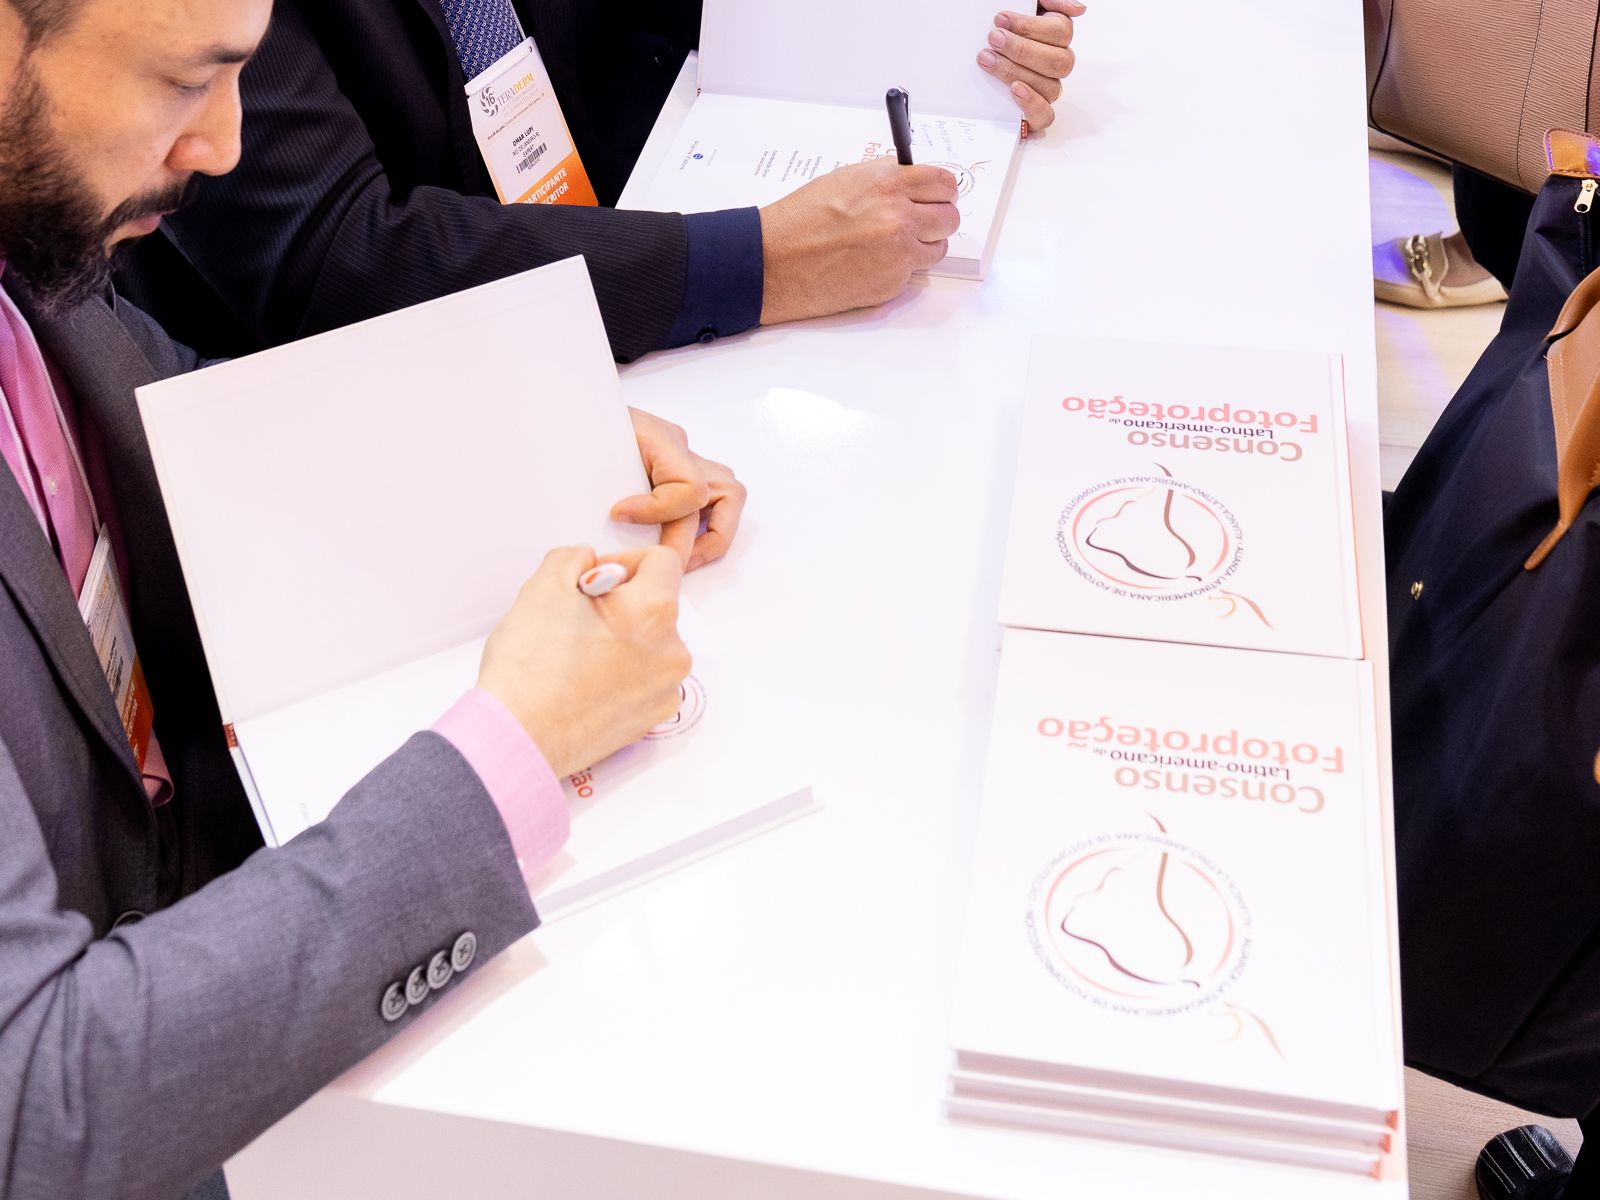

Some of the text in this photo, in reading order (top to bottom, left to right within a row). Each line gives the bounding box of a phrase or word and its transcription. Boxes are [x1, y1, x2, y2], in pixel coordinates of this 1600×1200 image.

[1061, 395, 1318, 434] Fotoproteção
[1108, 416, 1274, 439] Latino-americano de
[1126, 431, 1303, 462] Consenso
[1037, 716, 1344, 774] Fotoproteção
[1110, 749, 1290, 780] Latino-americano
[1114, 765, 1326, 814] Consenso
